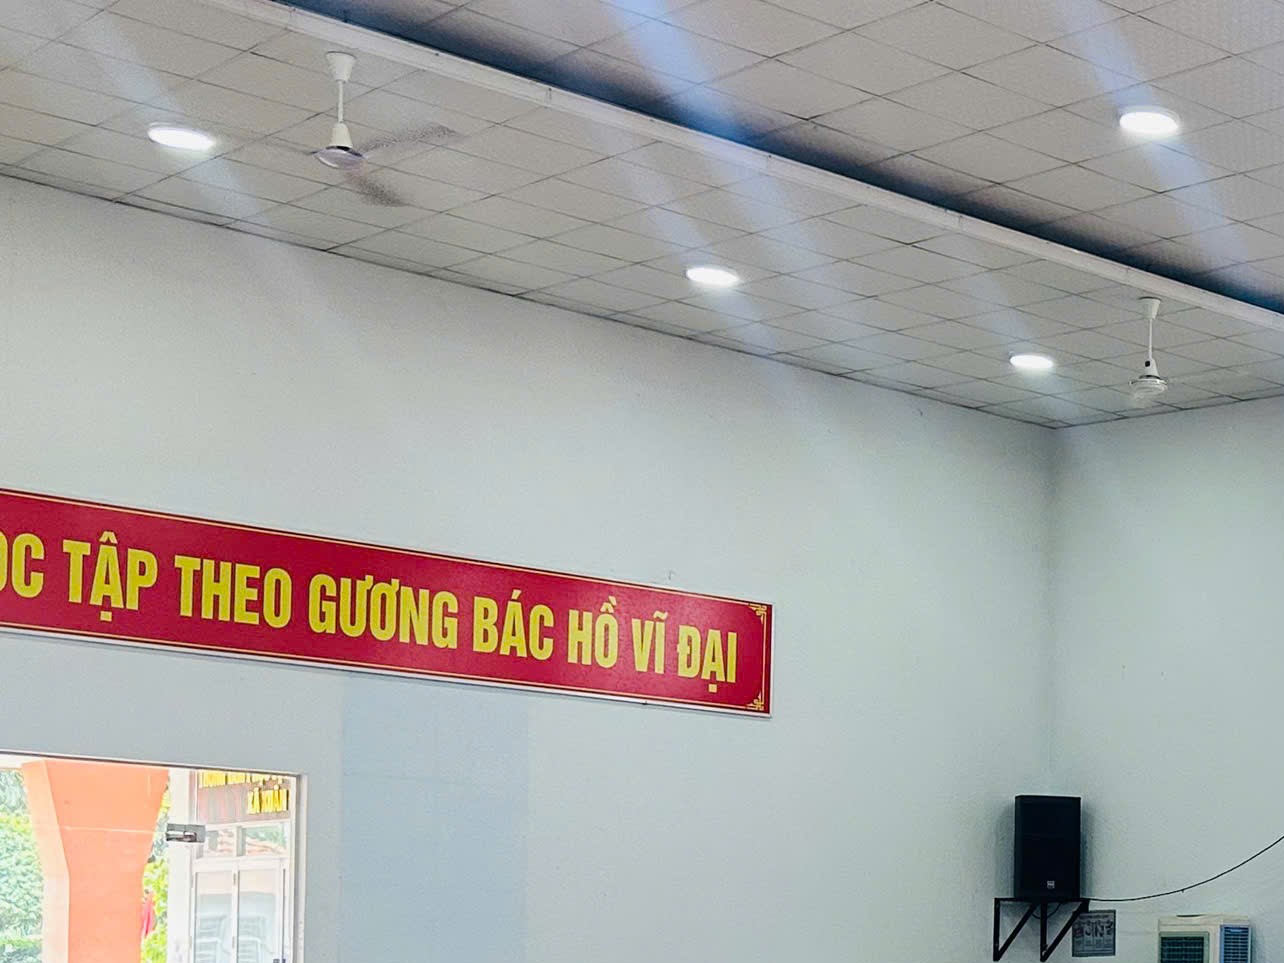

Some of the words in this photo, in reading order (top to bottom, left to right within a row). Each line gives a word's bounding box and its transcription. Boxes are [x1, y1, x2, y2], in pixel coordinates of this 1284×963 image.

[0, 531, 45, 598] C
[62, 531, 159, 622] TẬP
[174, 554, 293, 629] THEO
[308, 573, 459, 650] GƯƠNG
[472, 588, 555, 661] BÁC
[567, 595, 619, 669] HỒ
[631, 610, 669, 675] VĨ
[676, 624, 737, 693] ĐẠI
